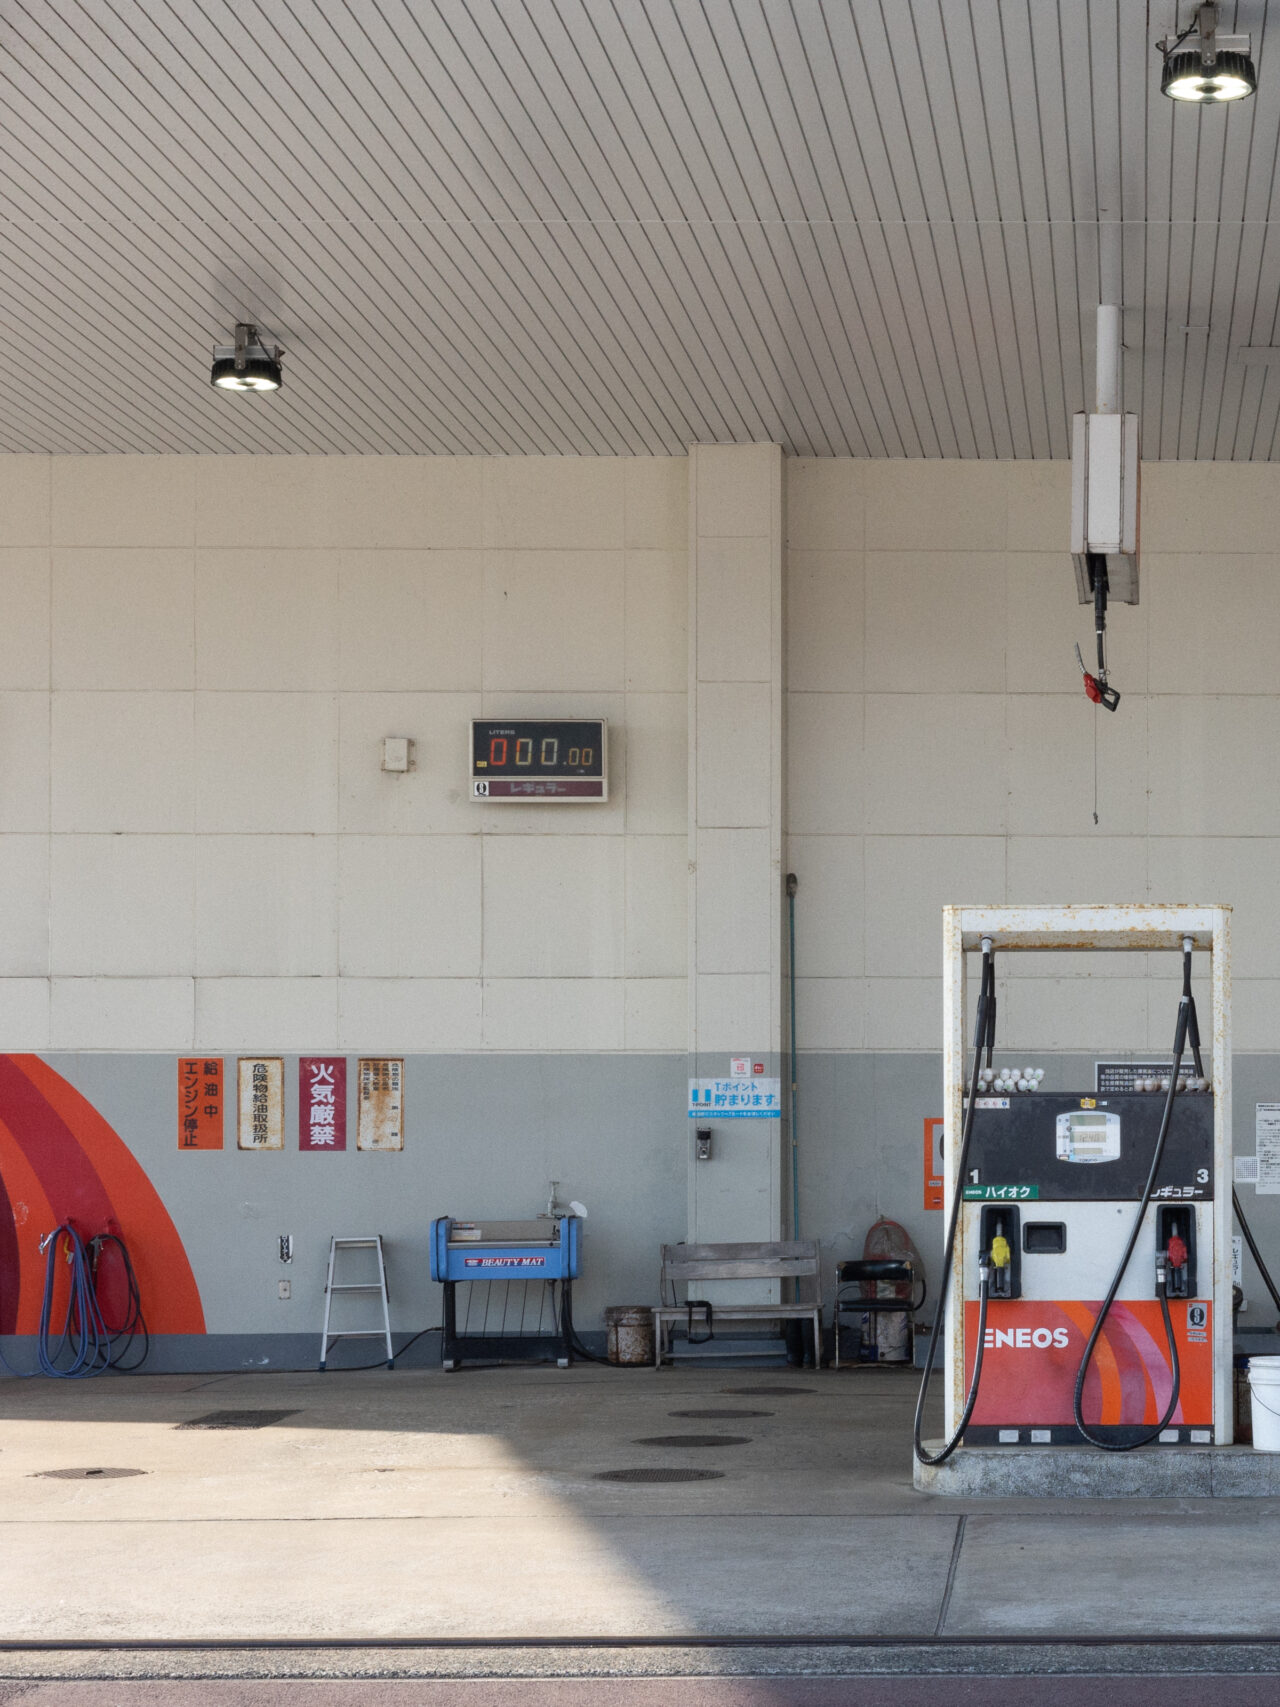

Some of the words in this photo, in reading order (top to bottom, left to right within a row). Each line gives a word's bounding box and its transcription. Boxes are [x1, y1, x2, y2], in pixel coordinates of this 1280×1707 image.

[510, 782, 567, 794] レギュラー
[203, 1062, 218, 1118] 給油中
[715, 1082, 758, 1092] Tポイント
[183, 1062, 199, 1147] エンジン停止
[252, 1063, 268, 1144] 危険物給油取扱所
[310, 1063, 335, 1145] 火気厳禁
[970, 1169, 979, 1184] 1
[1197, 1169, 1209, 1183] 3
[985, 1186, 1031, 1198] ハイオク
[481, 1258, 520, 1267] BEAUTY
[521, 1258, 544, 1266] MAT
[982, 1327, 1069, 1348] ENEOS
